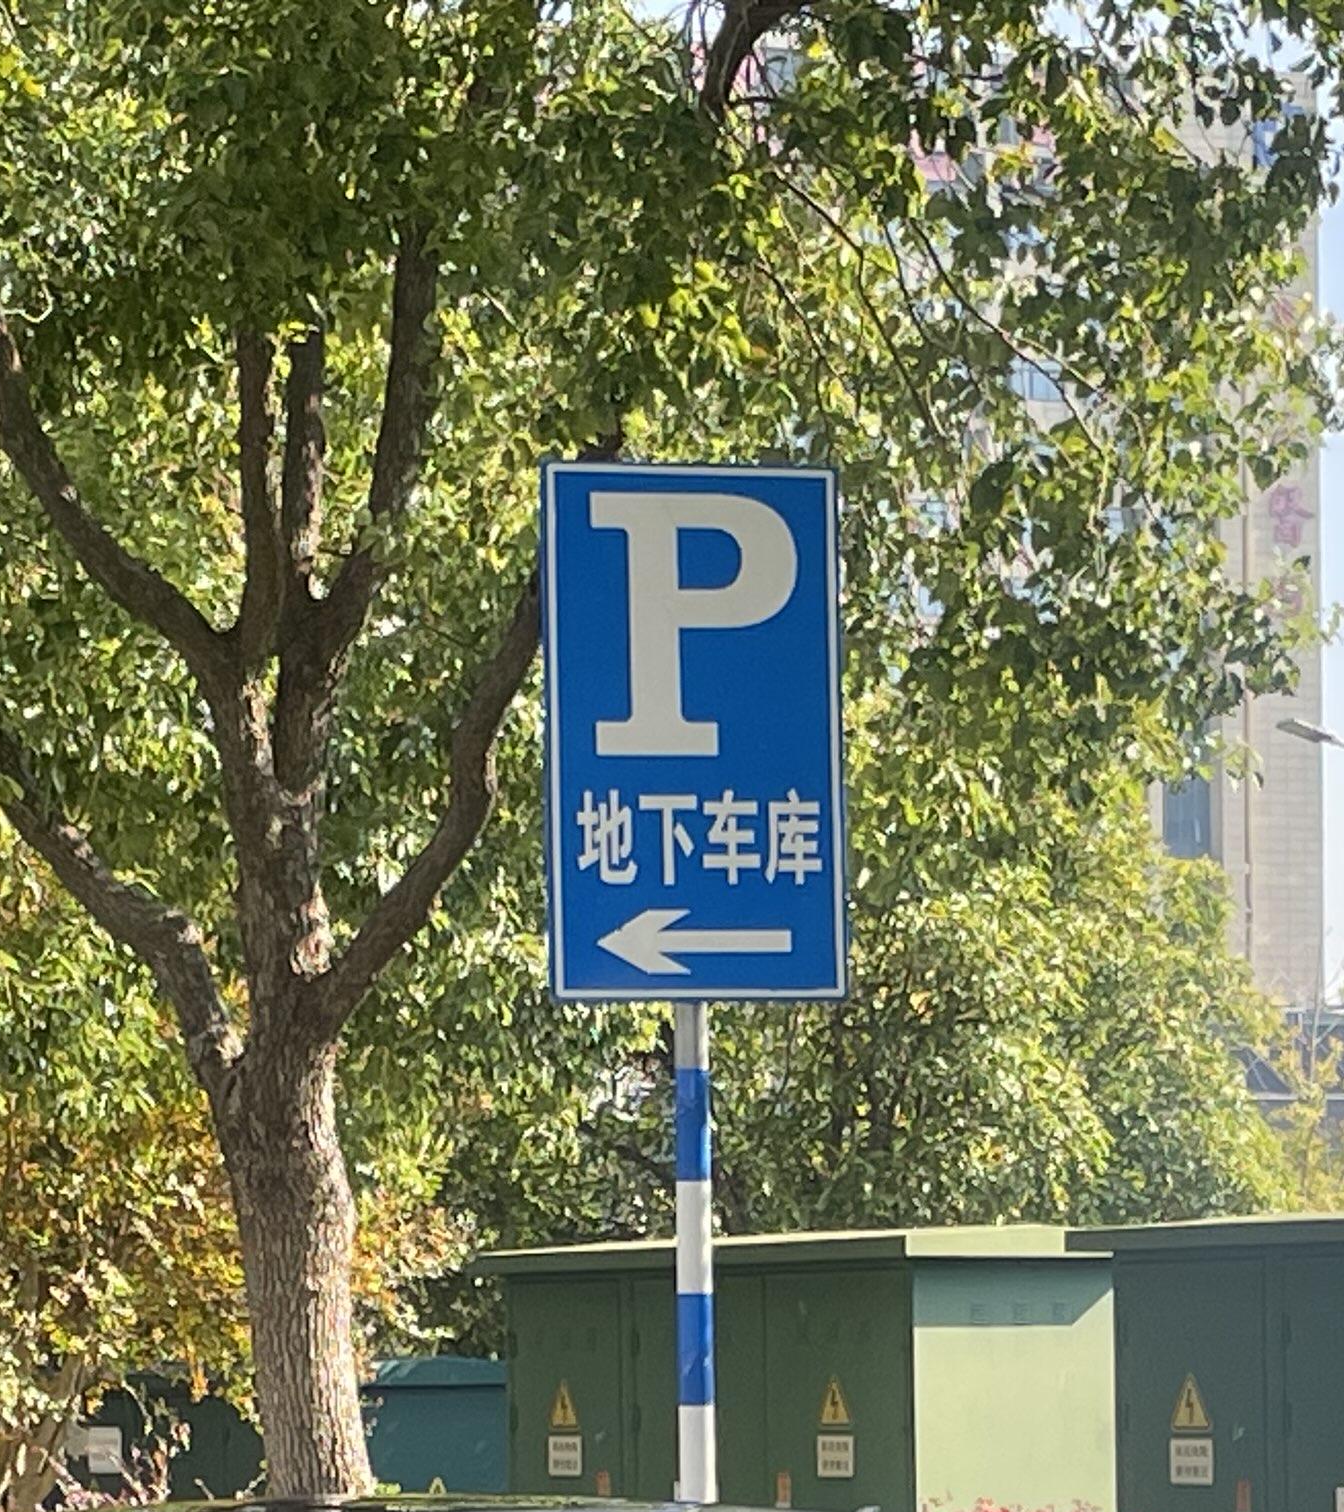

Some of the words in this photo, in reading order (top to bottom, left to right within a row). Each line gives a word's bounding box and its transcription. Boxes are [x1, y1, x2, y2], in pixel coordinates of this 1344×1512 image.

[589, 490, 798, 757] P
[576, 787, 823, 887] 地下车库
